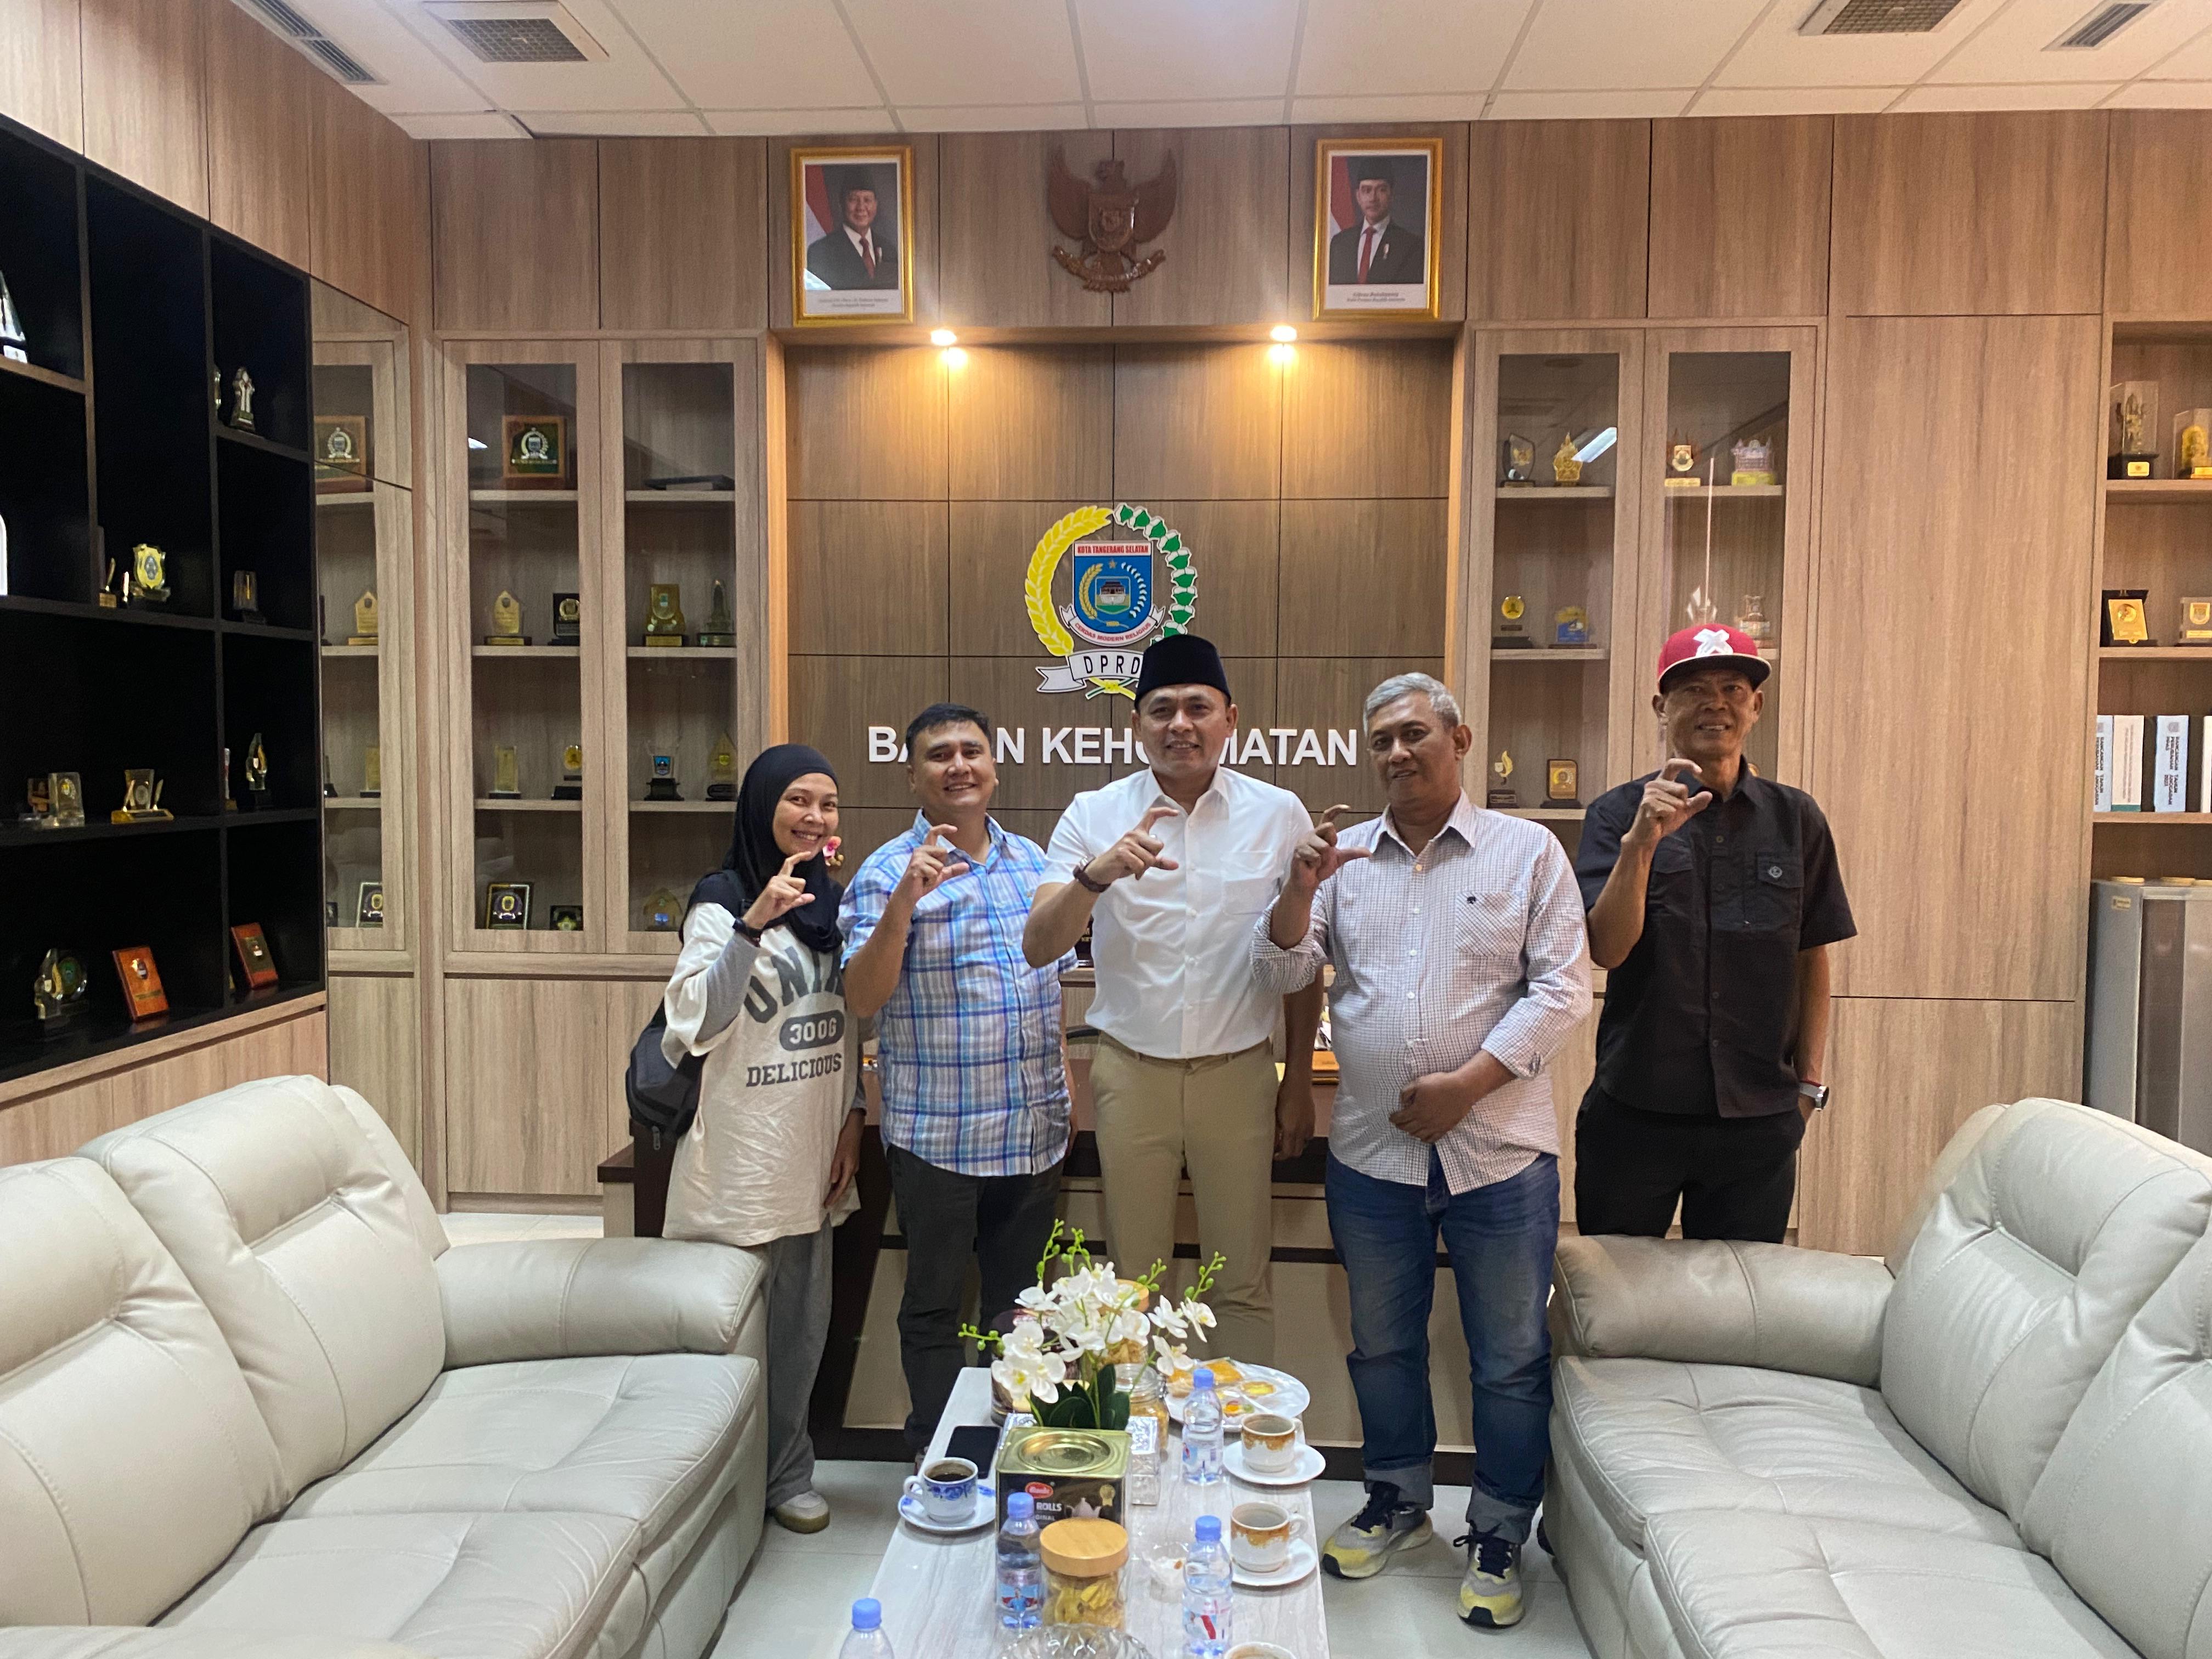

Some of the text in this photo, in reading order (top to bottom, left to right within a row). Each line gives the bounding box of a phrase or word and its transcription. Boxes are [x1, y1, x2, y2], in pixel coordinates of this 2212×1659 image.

[1077, 545, 1148, 554] KOTA TANGERANG SELATAN
[1075, 623, 1096, 639] CERDAS
[1125, 622, 1151, 640] RELIGIUS
[1084, 655, 1140, 674] DPRD
[1042, 727, 1357, 765] KEHATAN
[746, 1052, 842, 1087] DELICIOUS
[1036, 1502, 1062, 1512] ROLLS
